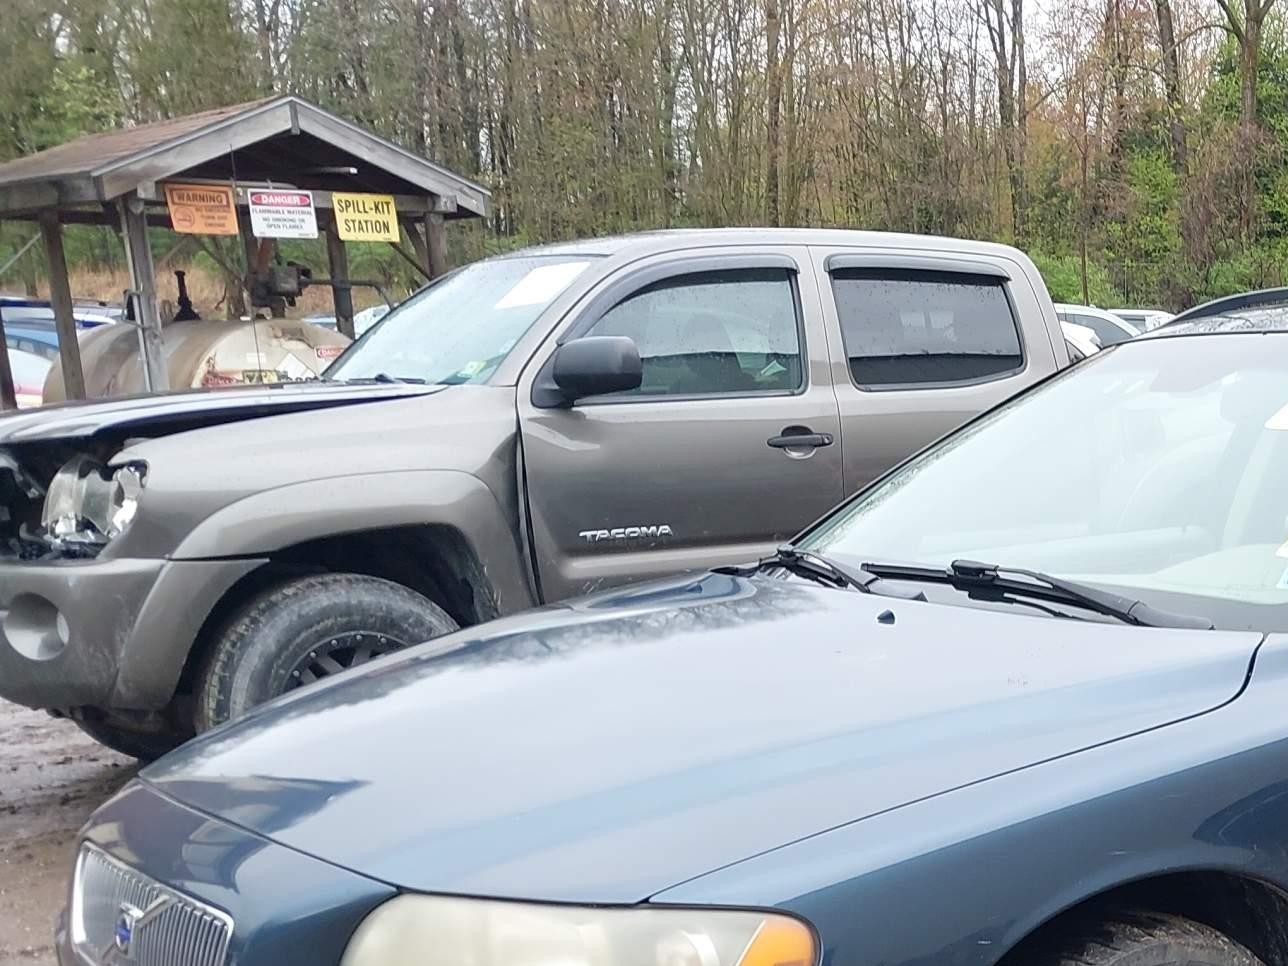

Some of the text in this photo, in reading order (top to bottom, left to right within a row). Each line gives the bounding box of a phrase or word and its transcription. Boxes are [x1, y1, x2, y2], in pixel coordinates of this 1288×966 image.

[175, 191, 223, 204] WARNING
[261, 194, 301, 205] DANGER
[337, 199, 391, 214] SPILL-KIT
[344, 219, 390, 234] STATION
[579, 525, 673, 543] TACOMA
